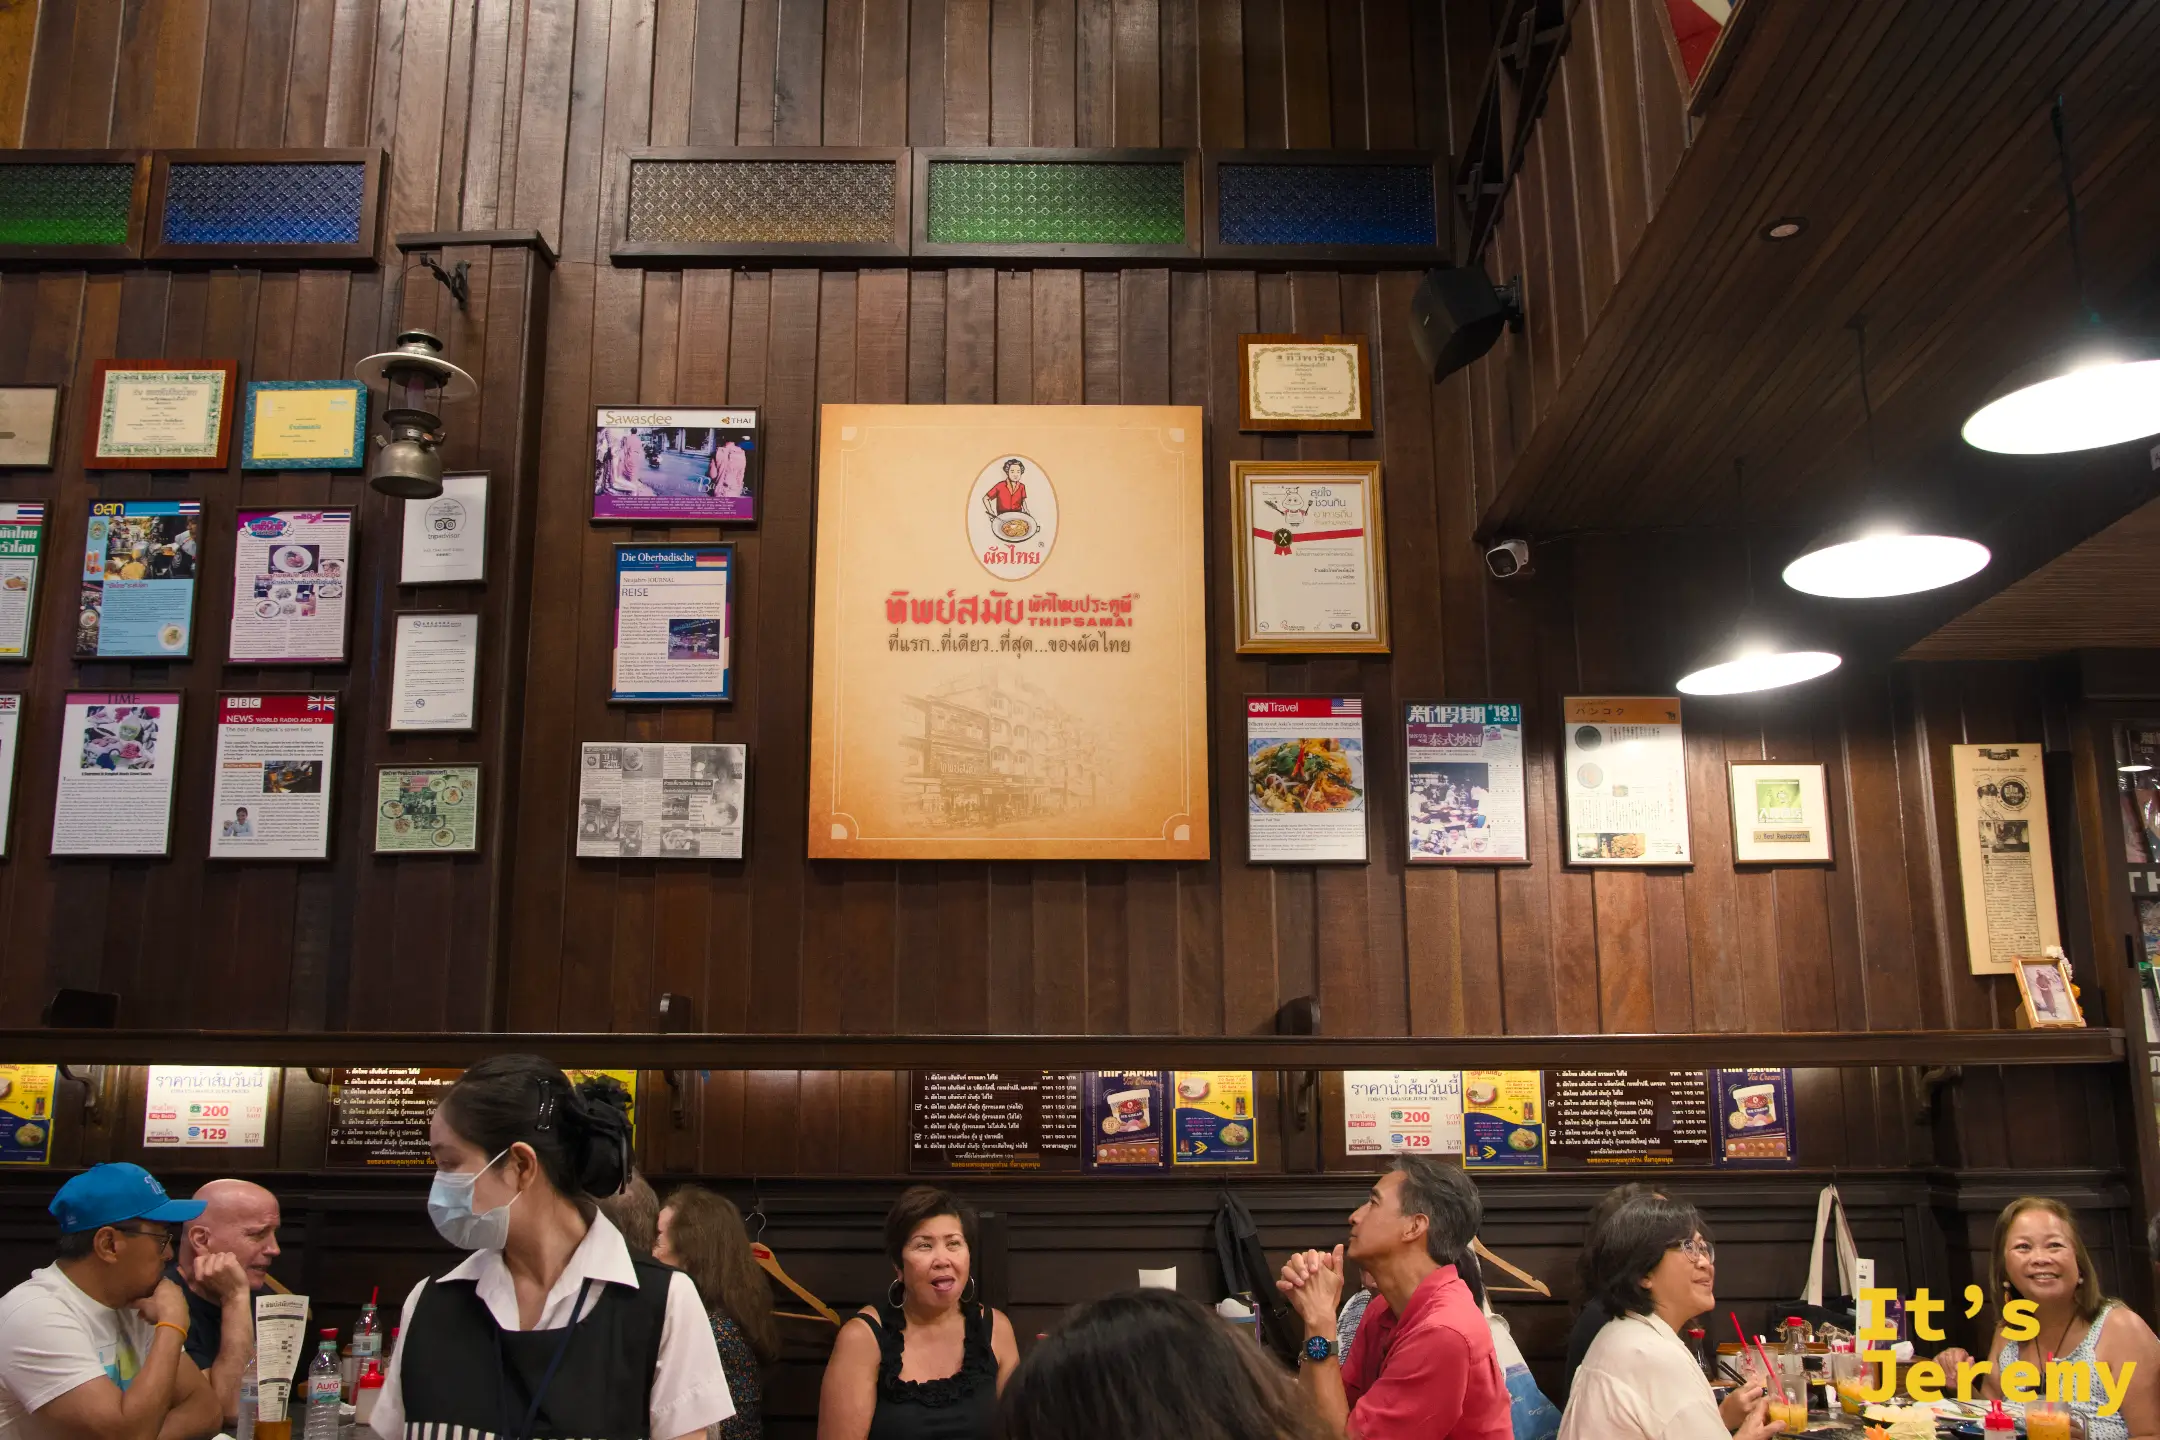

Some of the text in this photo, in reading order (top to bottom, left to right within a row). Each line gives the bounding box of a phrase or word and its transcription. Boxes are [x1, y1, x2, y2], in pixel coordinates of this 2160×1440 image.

[605, 410, 673, 425] Sawasdee
[732, 417, 752, 425] THAI
[427, 532, 461, 541] tripadvisor
[621, 552, 694, 562] Die Oberbadische
[983, 544, 1041, 565] ผัดไทย
[621, 588, 649, 597] REISE
[886, 589, 1024, 625] ทิพย์สมัย
[1027, 617, 1133, 628] THIPSAMAI
[108, 693, 141, 704] TIME
[229, 698, 260, 708] BBC
[1248, 702, 1299, 713] CNN Travel
[1576, 708, 1625, 716] バンコク
[226, 715, 254, 723] NEWS
[1408, 705, 1486, 724] 新假期
[1351, 1073, 1460, 1096] ราคาน้ำส้มวันนี้
[202, 1105, 229, 1117] 200
[1403, 1111, 1431, 1123] 200
[201, 1128, 227, 1140] 129
[1404, 1135, 1431, 1147] 129
